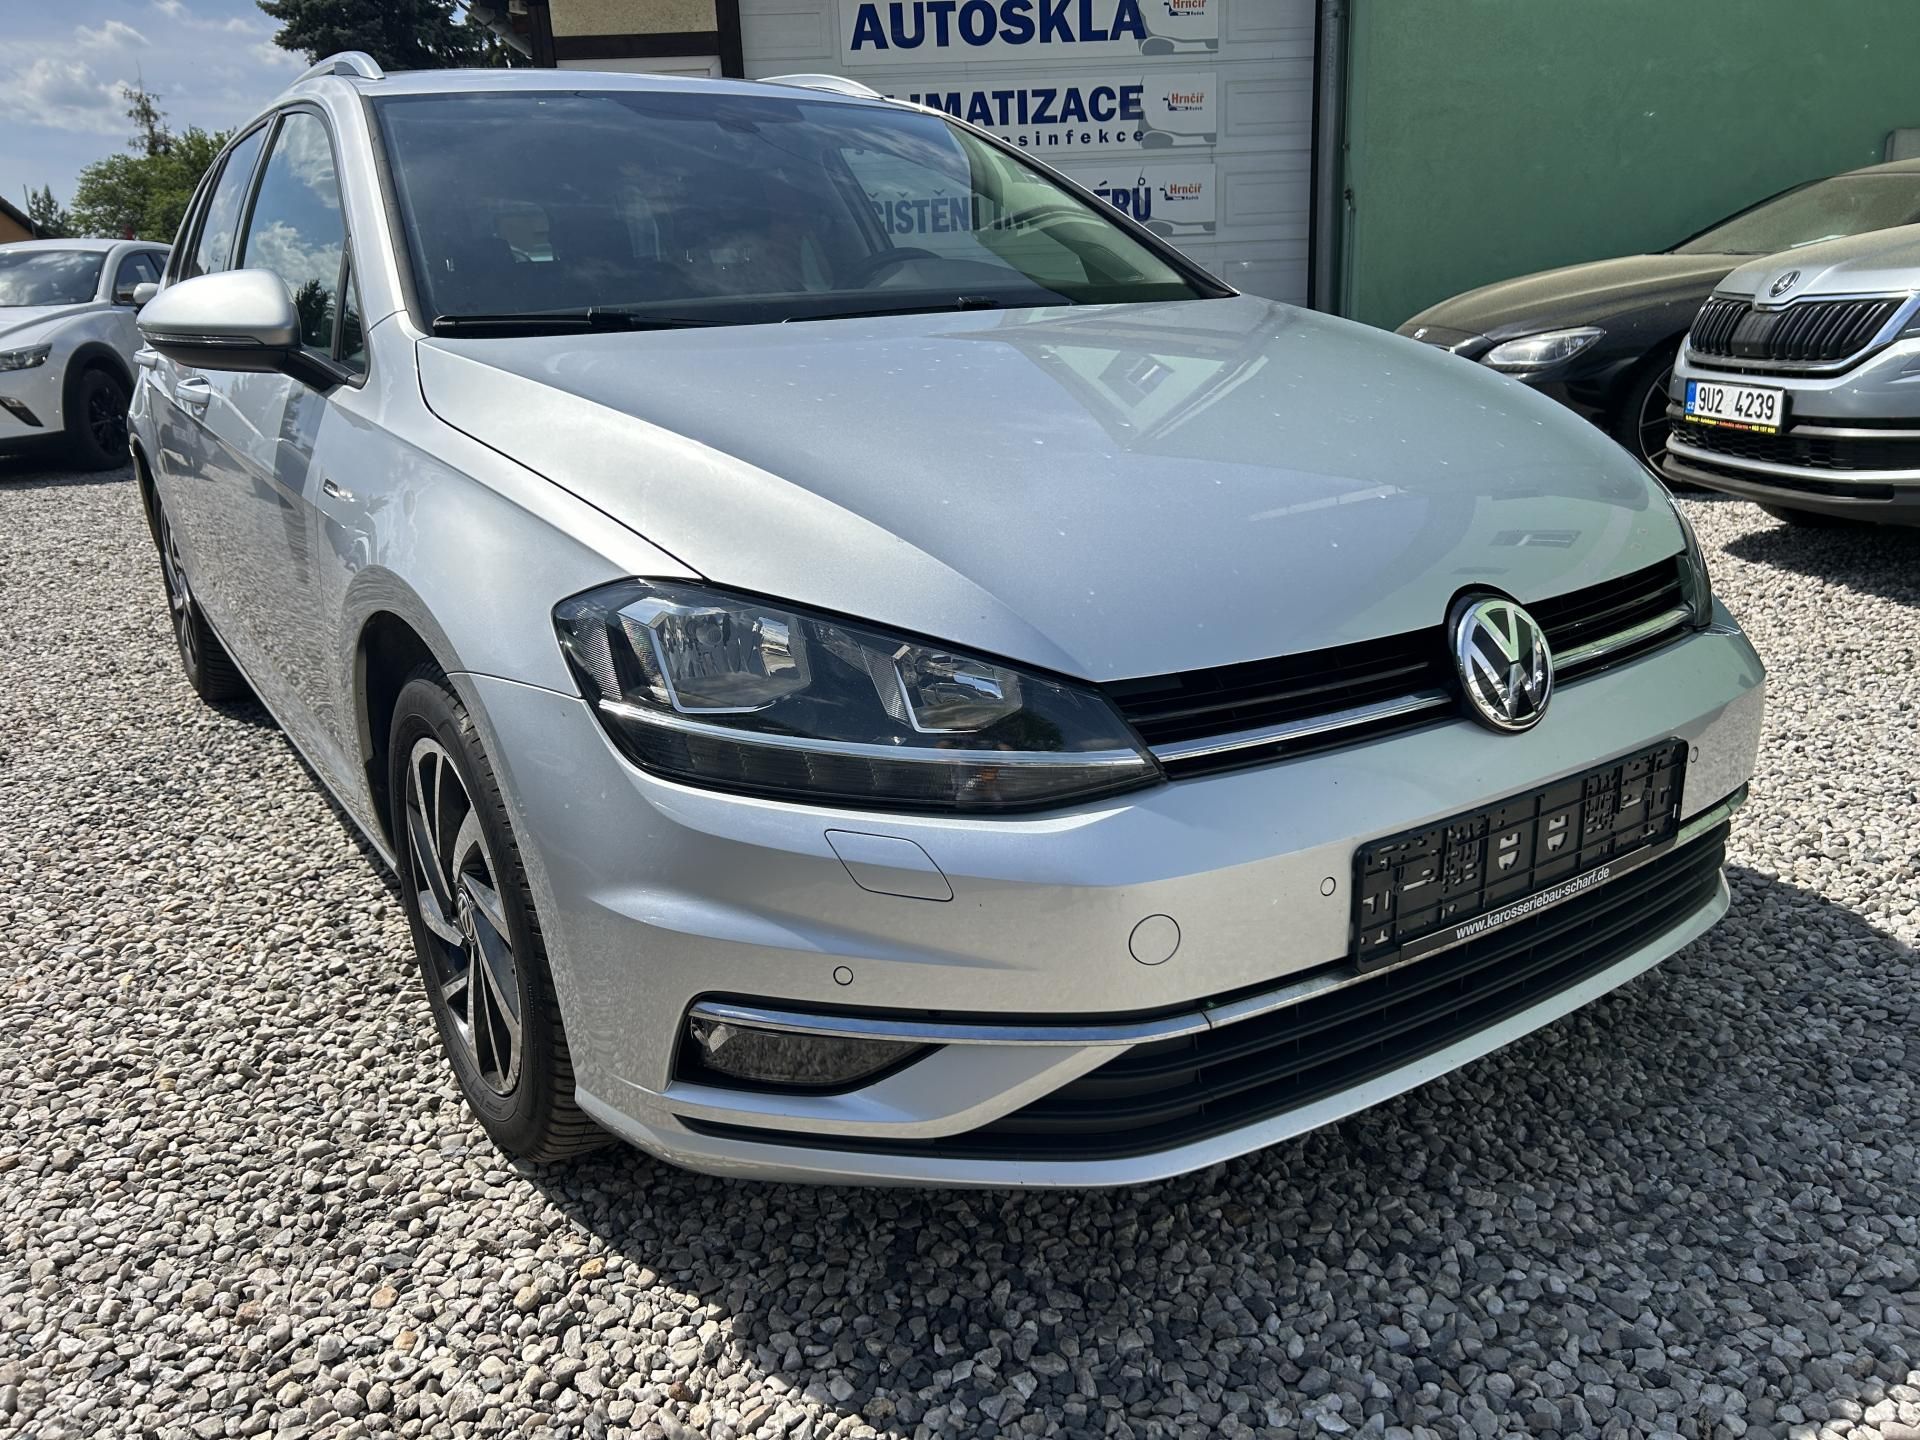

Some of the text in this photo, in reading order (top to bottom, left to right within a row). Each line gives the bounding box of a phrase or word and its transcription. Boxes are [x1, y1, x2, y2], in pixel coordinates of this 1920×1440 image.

[850, 0, 1148, 51] AUTOSKLA
[1698, 386, 1775, 420] 9U2 4239
[1456, 866, 1610, 939] www.karosseriebau-scharf.de
